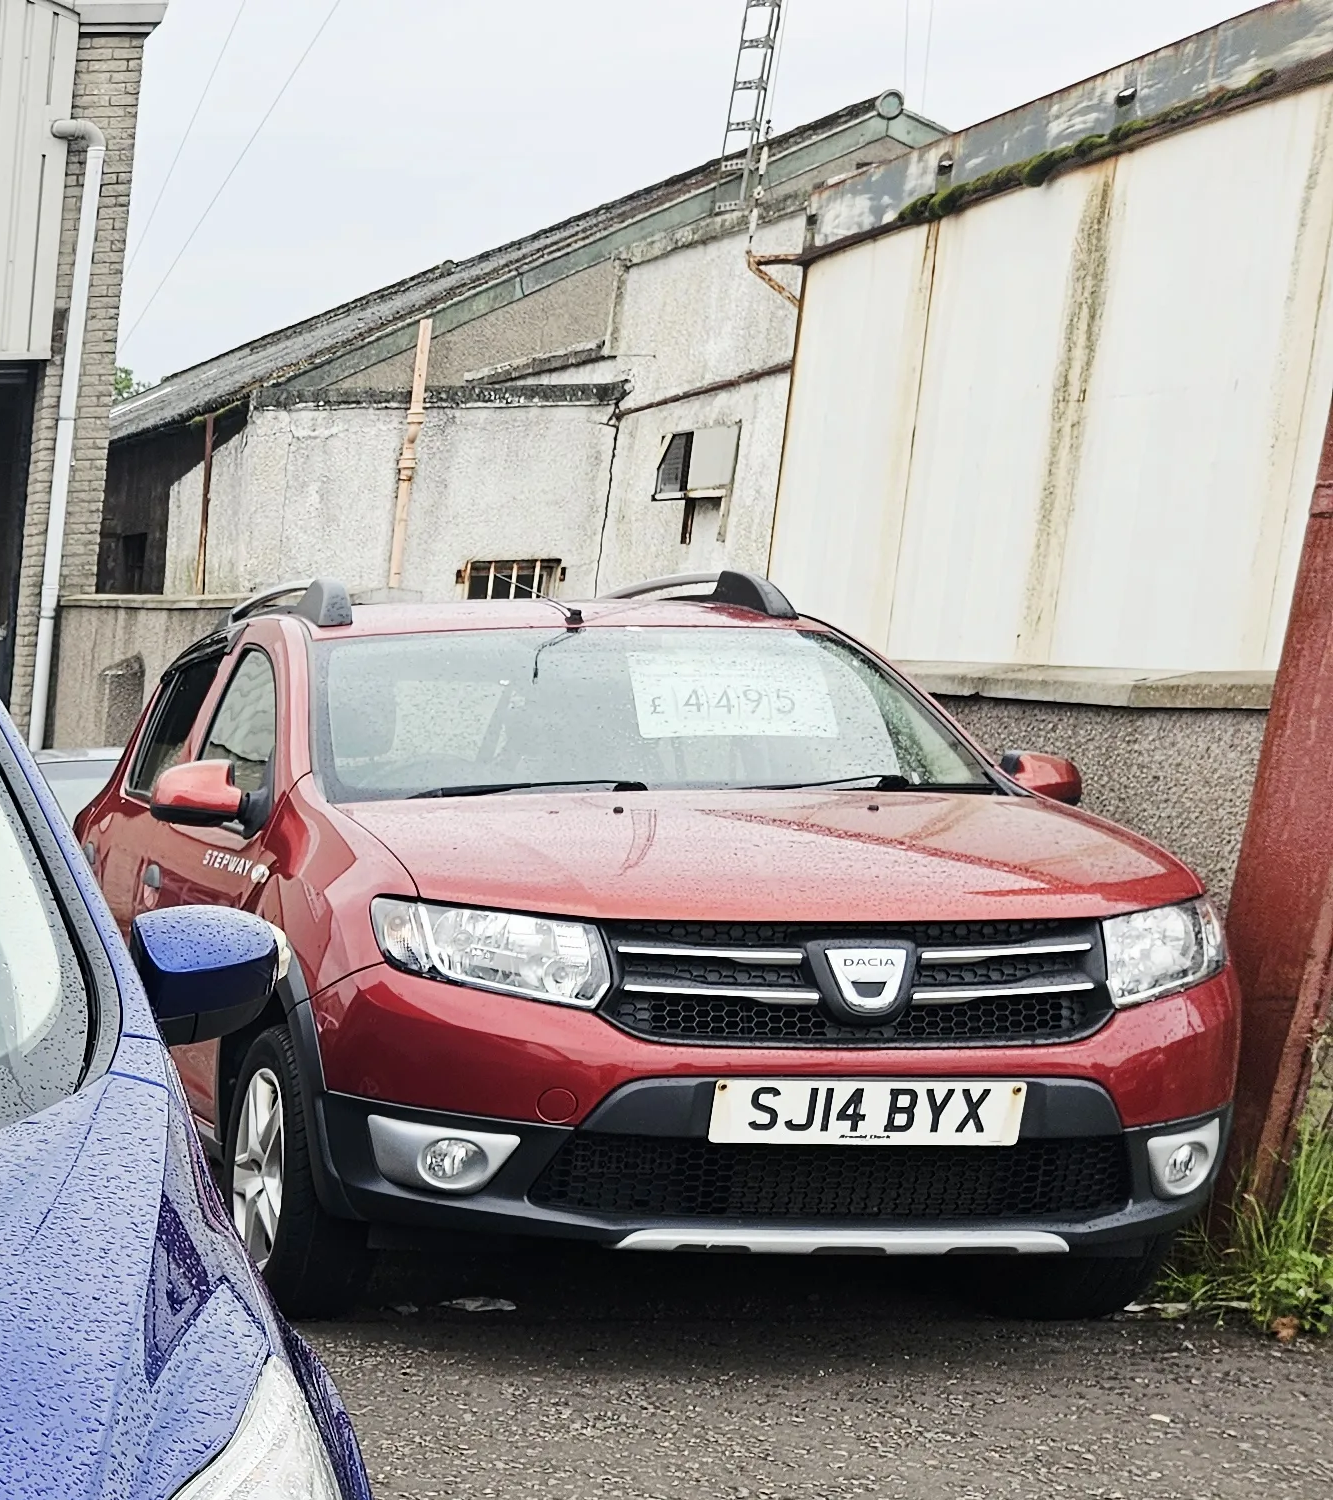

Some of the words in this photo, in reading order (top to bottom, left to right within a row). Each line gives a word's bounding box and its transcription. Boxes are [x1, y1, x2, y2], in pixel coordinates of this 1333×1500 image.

[202, 848, 253, 877] STEPWAY
[843, 958, 895, 967] DACIA
[747, 1086, 867, 1132] SJ14
[883, 1087, 992, 1133] BYX
